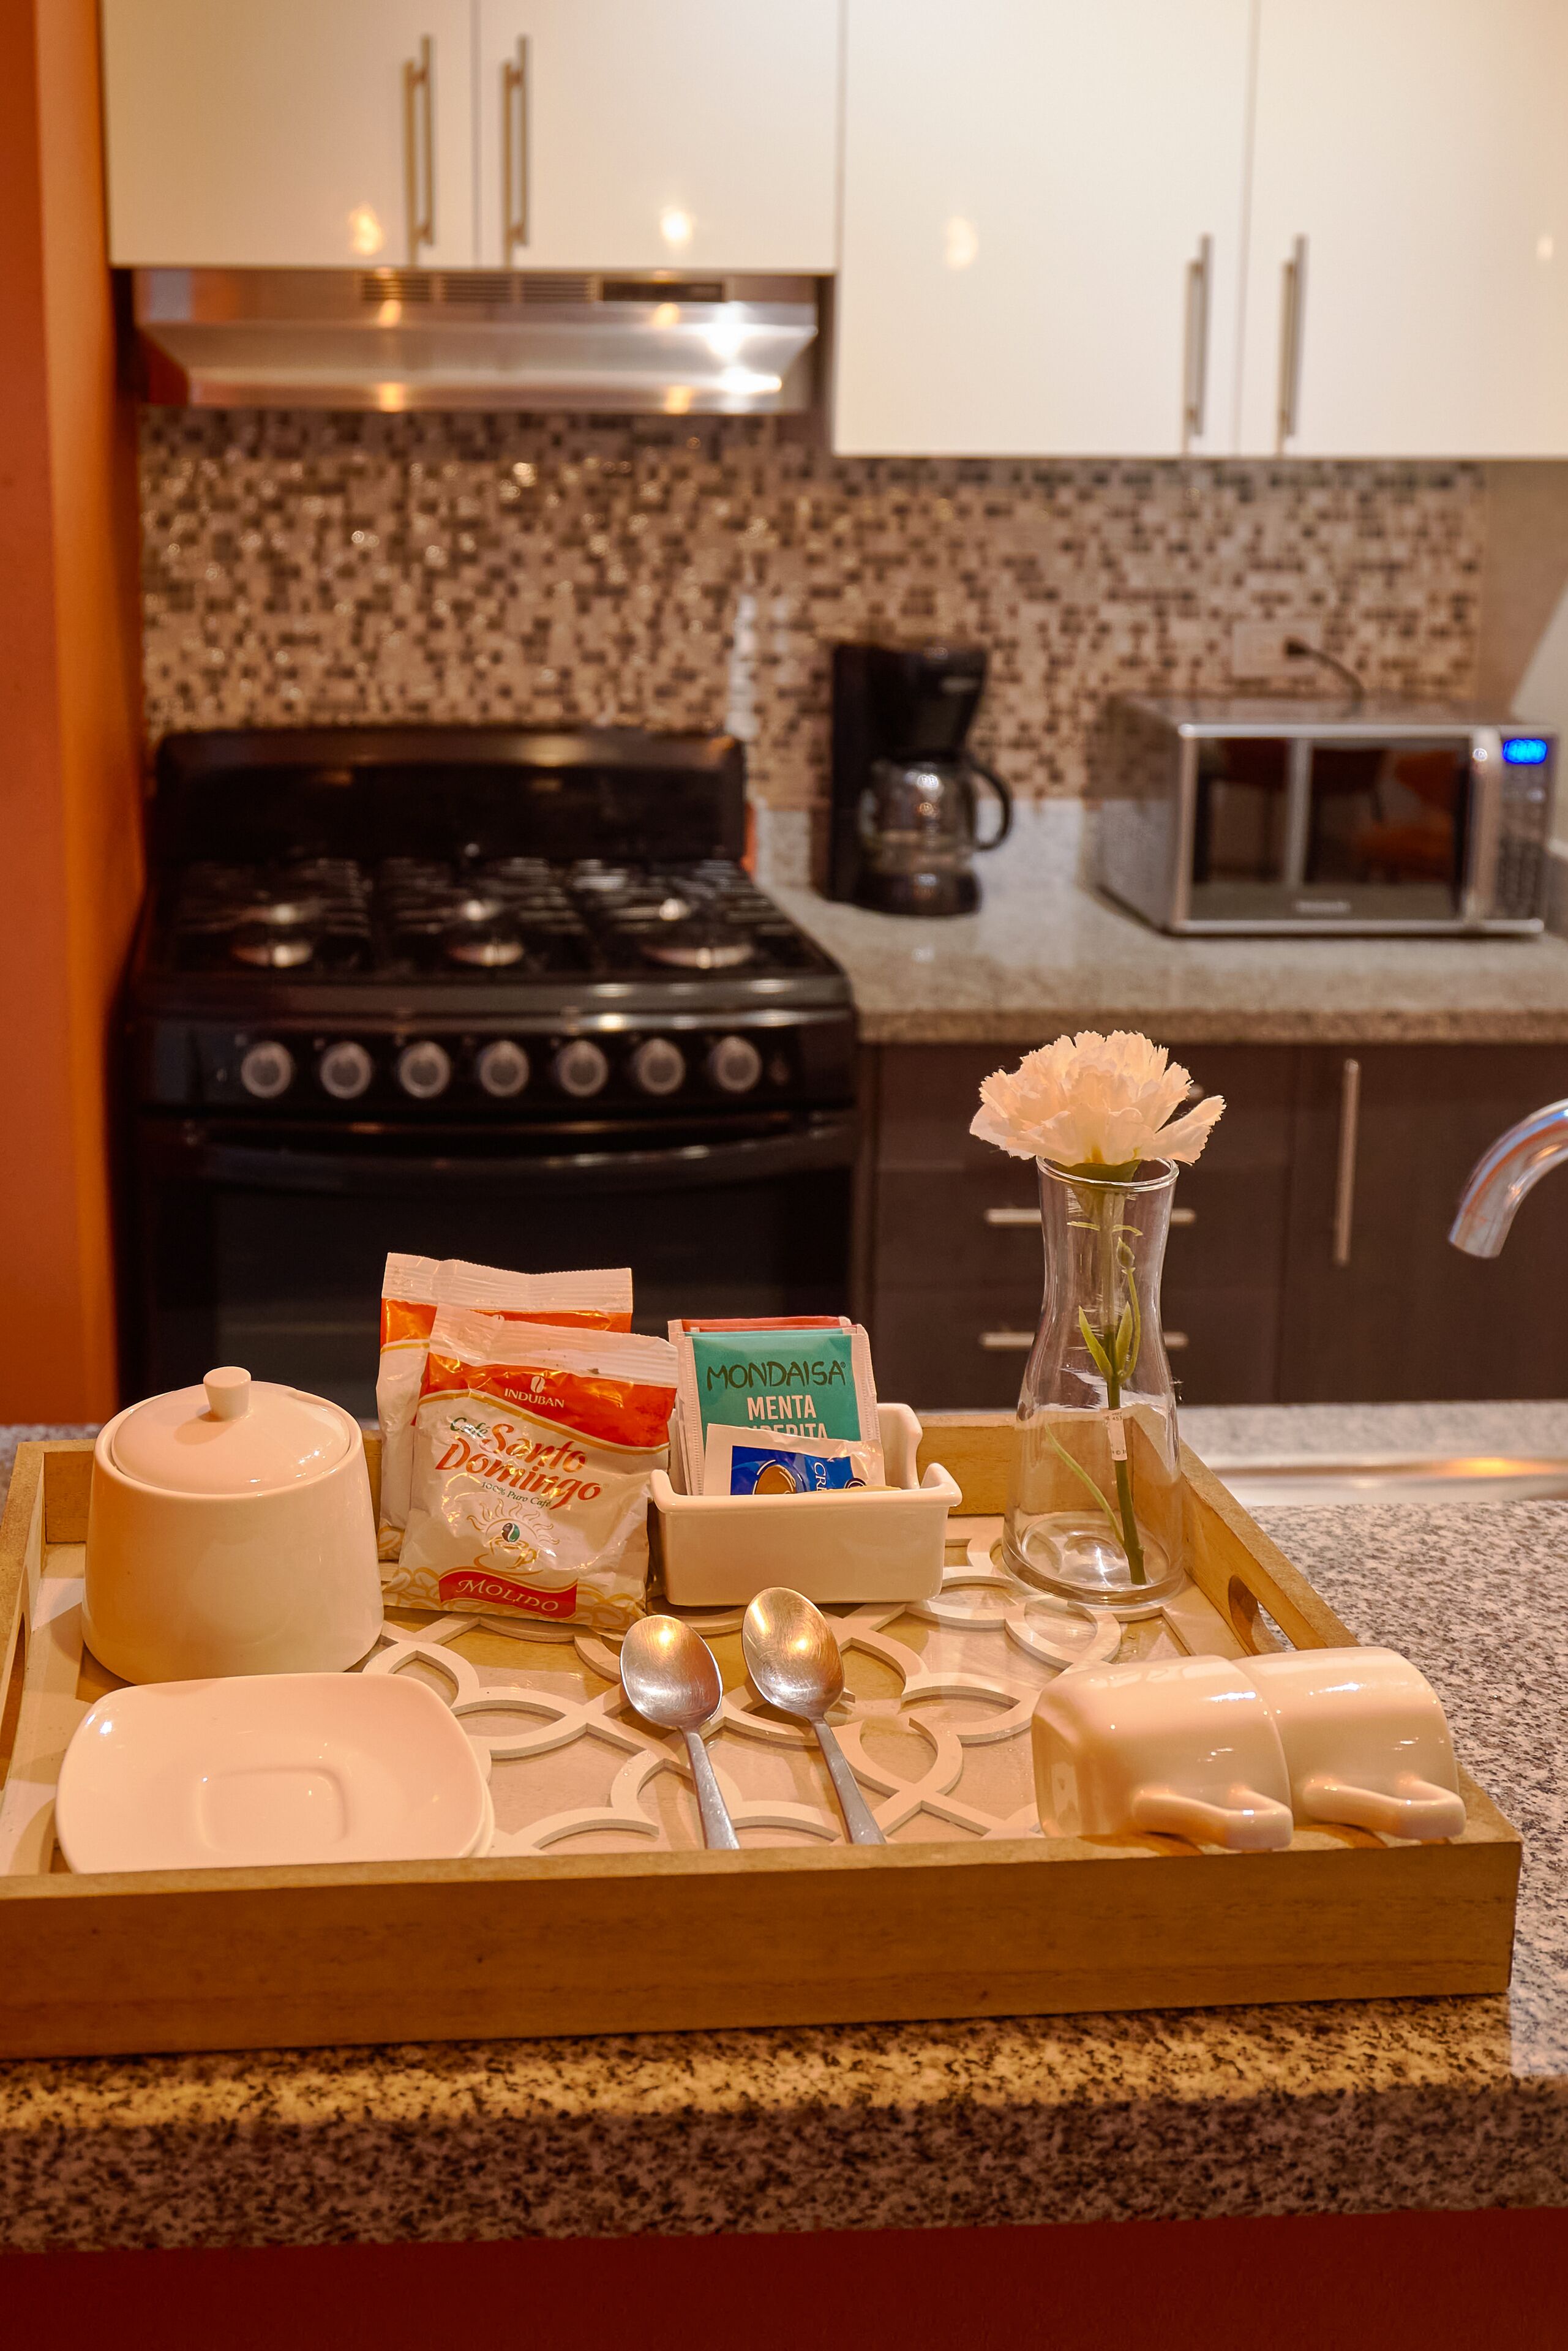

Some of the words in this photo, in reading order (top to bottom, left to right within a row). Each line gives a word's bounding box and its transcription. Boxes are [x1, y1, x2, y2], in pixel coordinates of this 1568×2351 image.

[707, 1360, 846, 1392] MONDAISA
[504, 1388, 565, 1408] INDUBAN
[746, 1395, 817, 1421] MENTA
[479, 1423, 586, 1473] Santo
[435, 1438, 601, 1510] Domingo
[481, 1482, 505, 1496] 100%
[506, 1491, 528, 1502] Puro
[456, 1579, 559, 1611] MOLIDO
